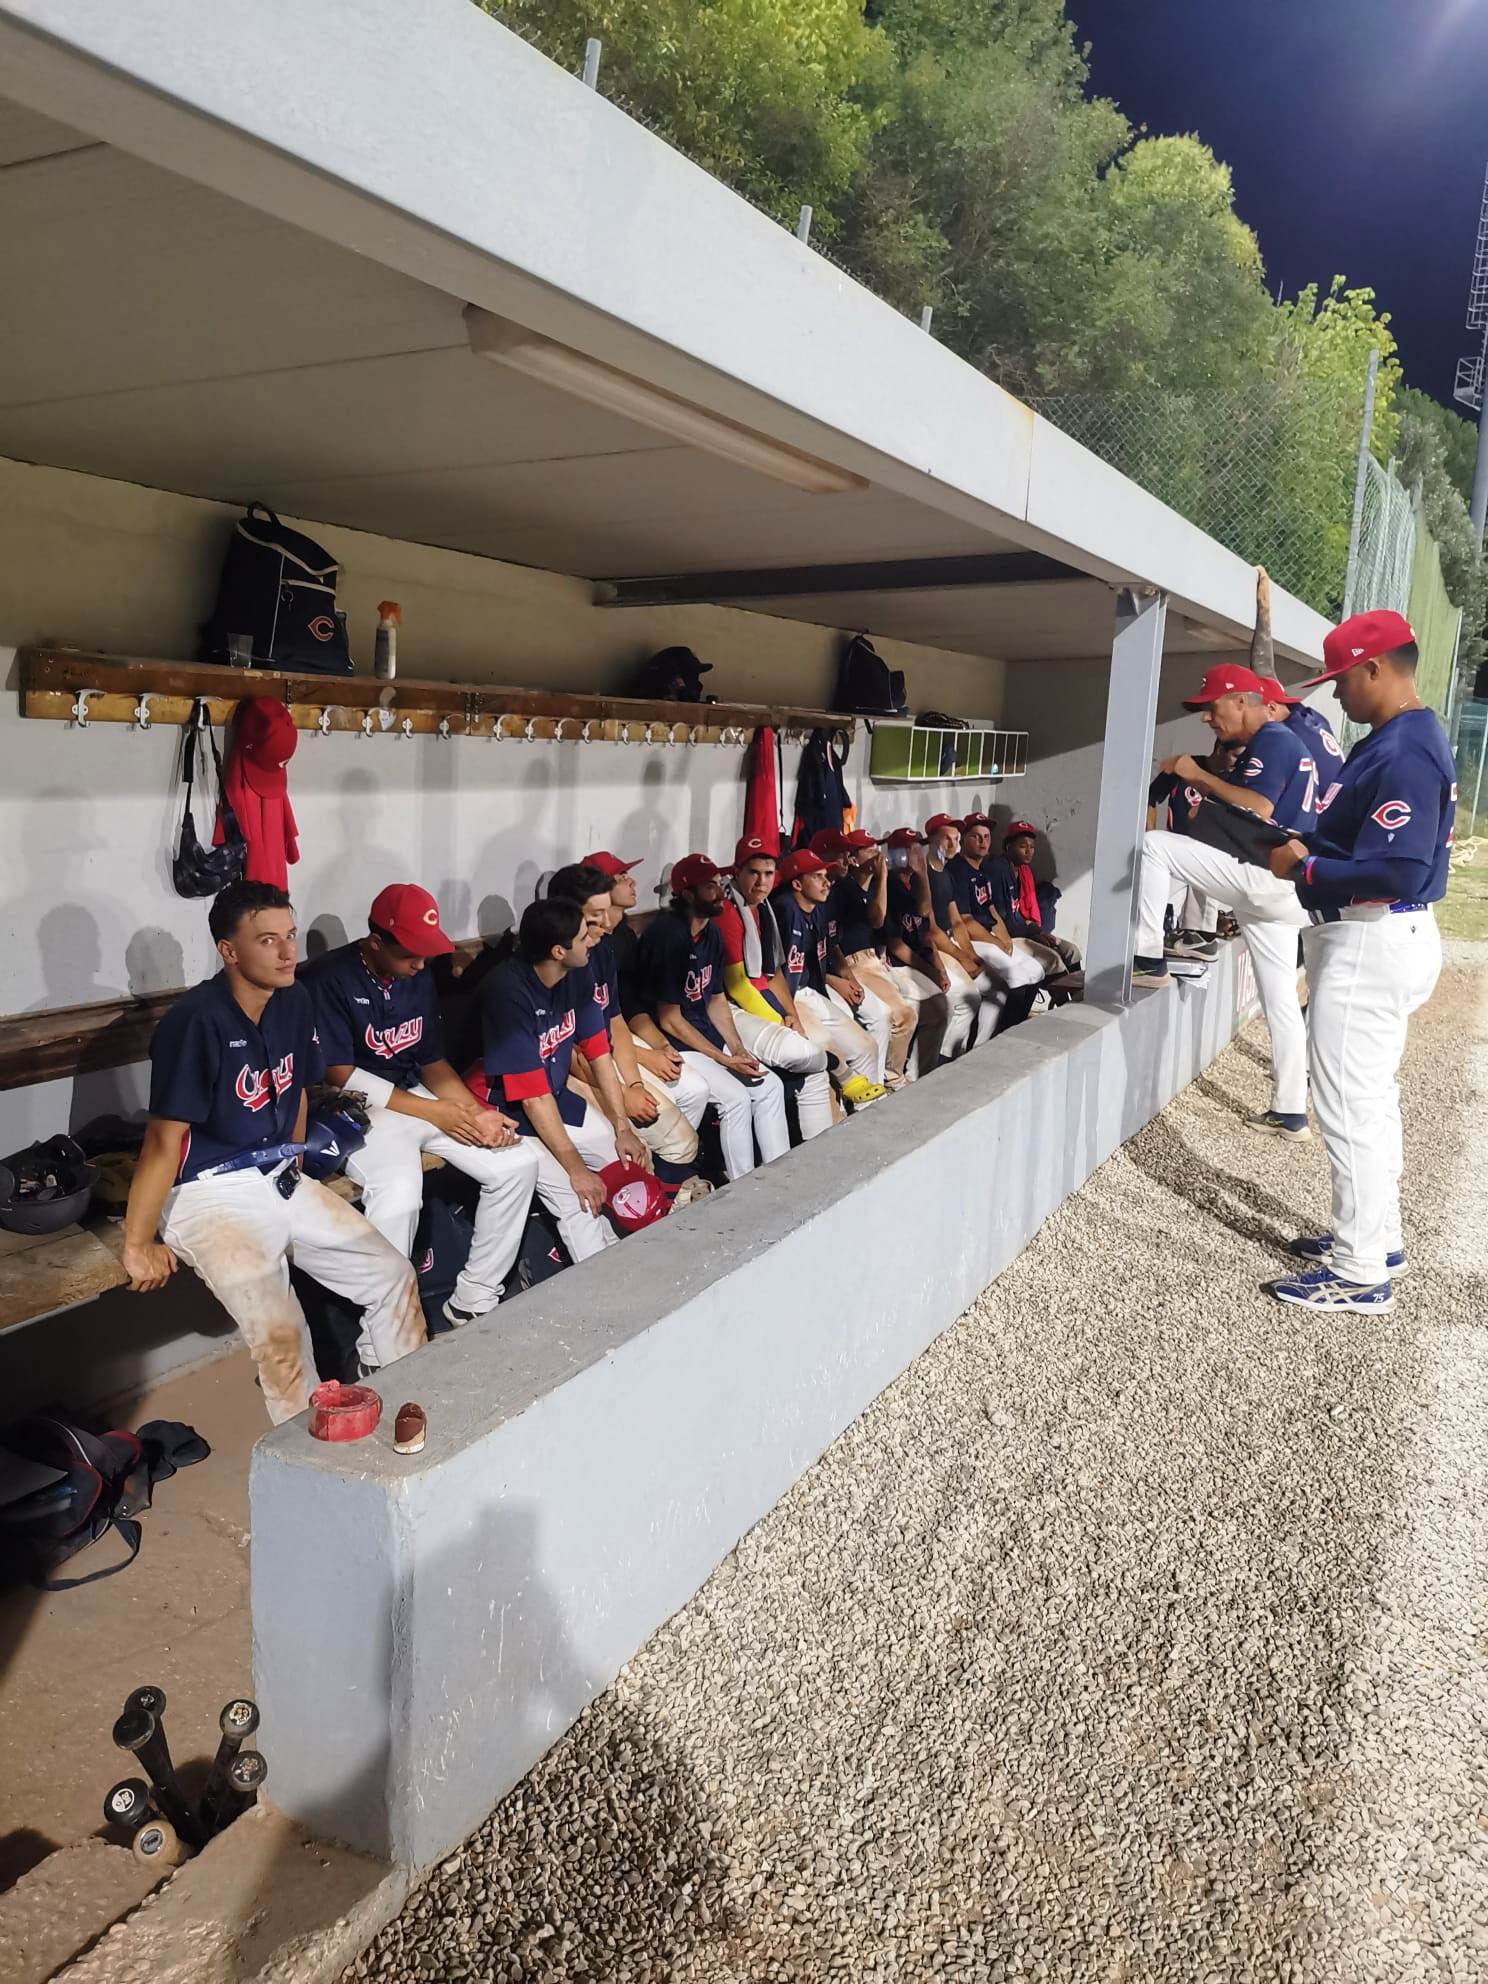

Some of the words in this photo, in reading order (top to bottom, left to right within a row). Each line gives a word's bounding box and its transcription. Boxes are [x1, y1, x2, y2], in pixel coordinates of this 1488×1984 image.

[307, 615, 335, 642] C
[1371, 800, 1412, 830] C
[748, 838, 762, 848] C
[423, 908, 438, 926] C
